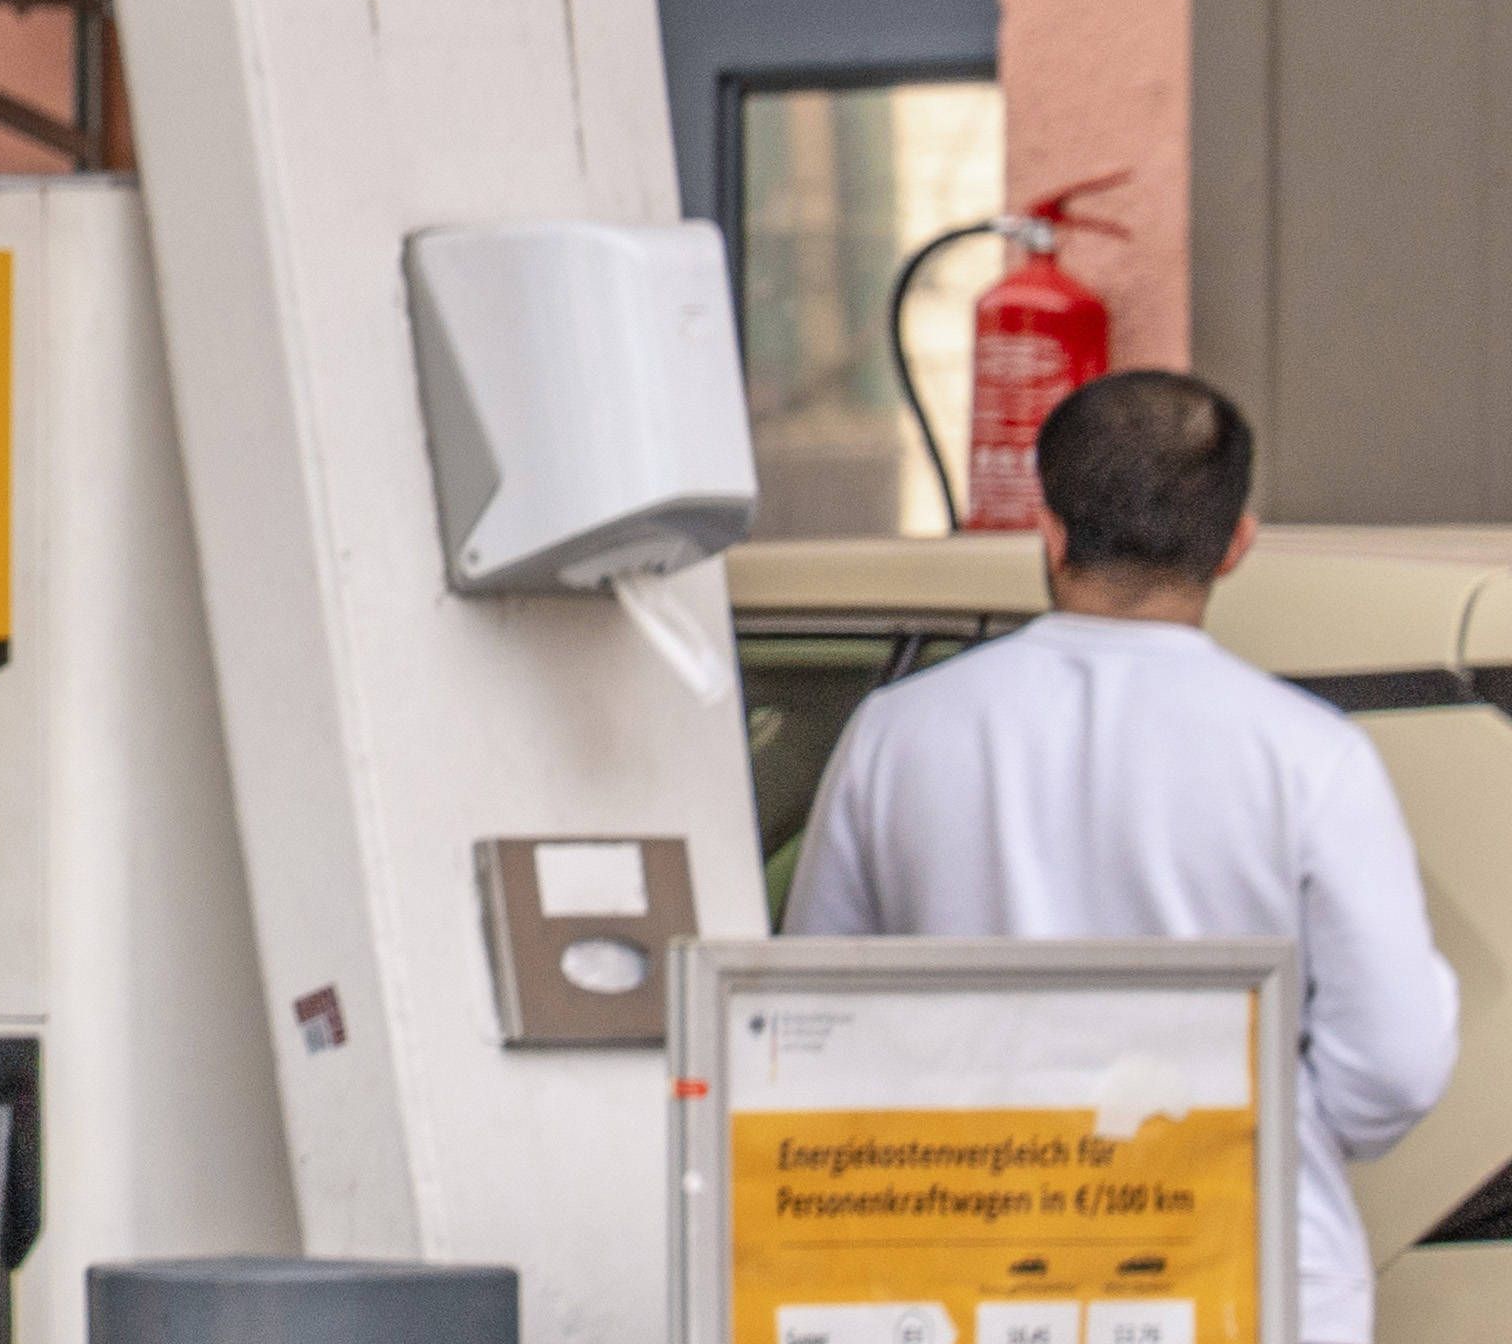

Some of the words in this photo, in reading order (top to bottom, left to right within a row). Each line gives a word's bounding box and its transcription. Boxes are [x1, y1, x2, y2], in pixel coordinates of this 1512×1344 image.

[776, 1183, 1033, 1224] Personenkraftwagen
[1039, 1184, 1067, 1215] in
[1153, 1181, 1195, 1214] km
